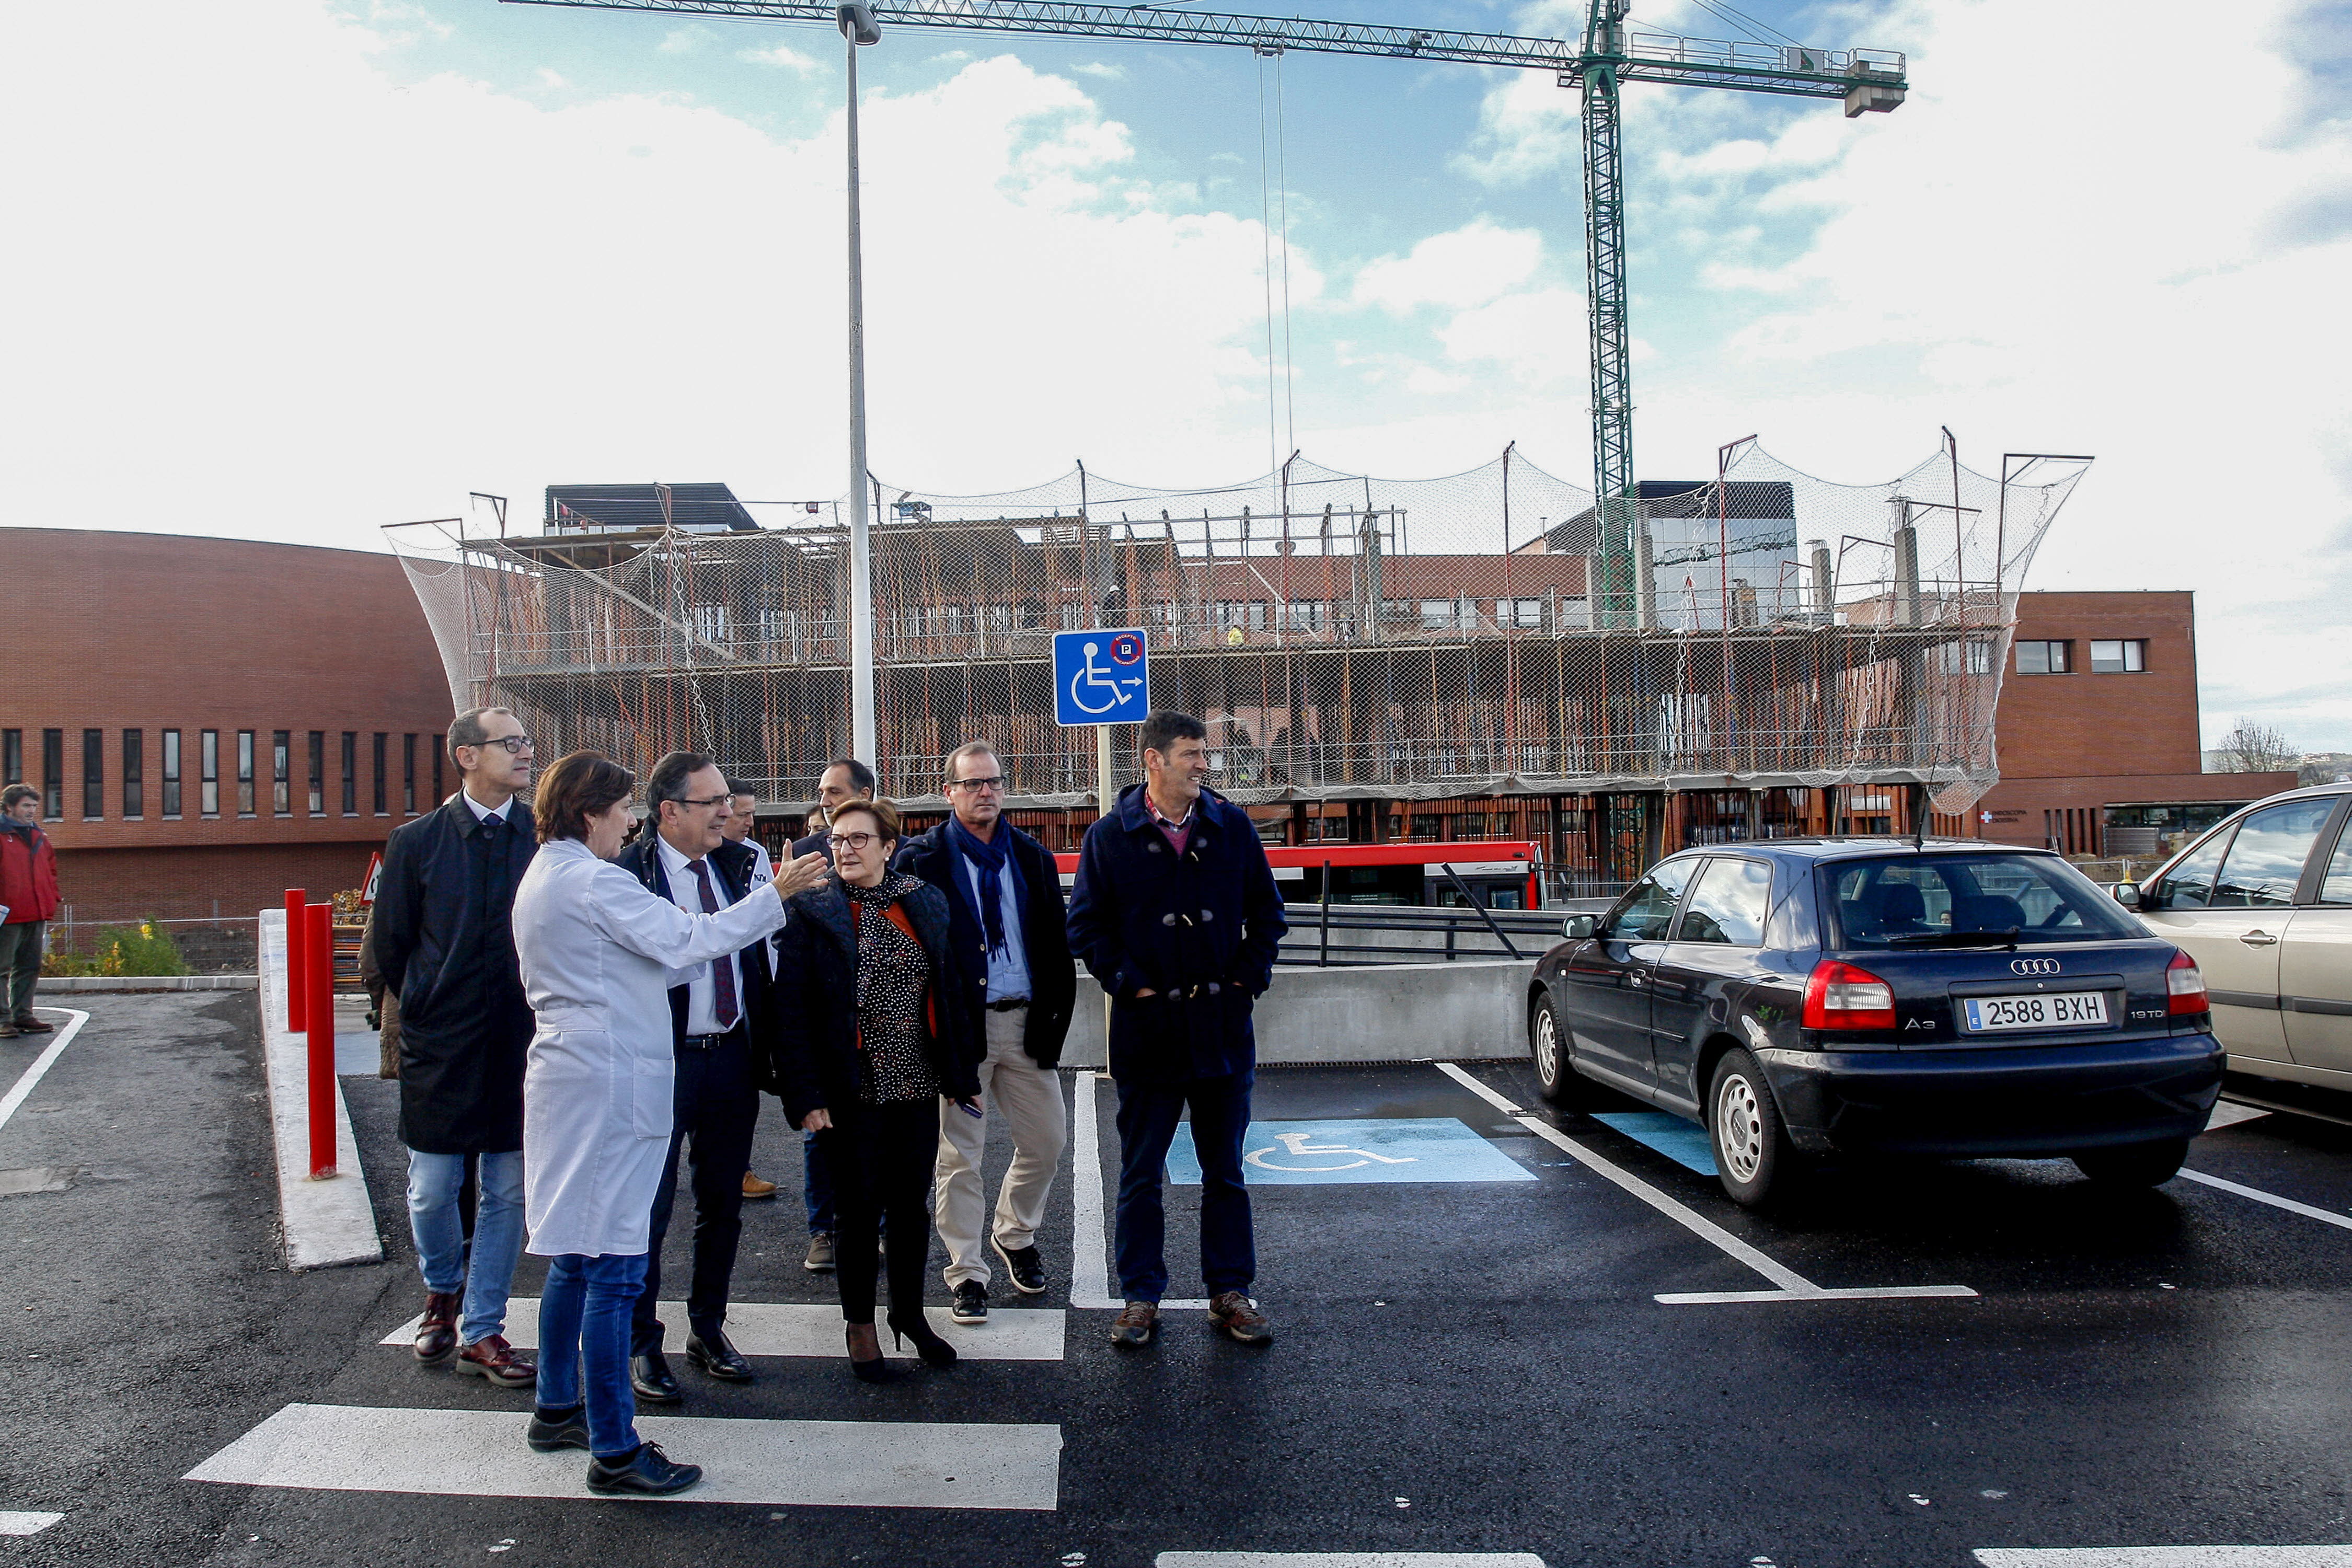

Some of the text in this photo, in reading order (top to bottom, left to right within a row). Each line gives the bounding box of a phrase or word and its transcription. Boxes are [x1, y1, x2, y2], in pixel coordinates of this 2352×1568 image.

[1987, 999, 2045, 1025] 2588
[2053, 996, 2100, 1021] BXH
[1905, 1018, 1935, 1030] A3
